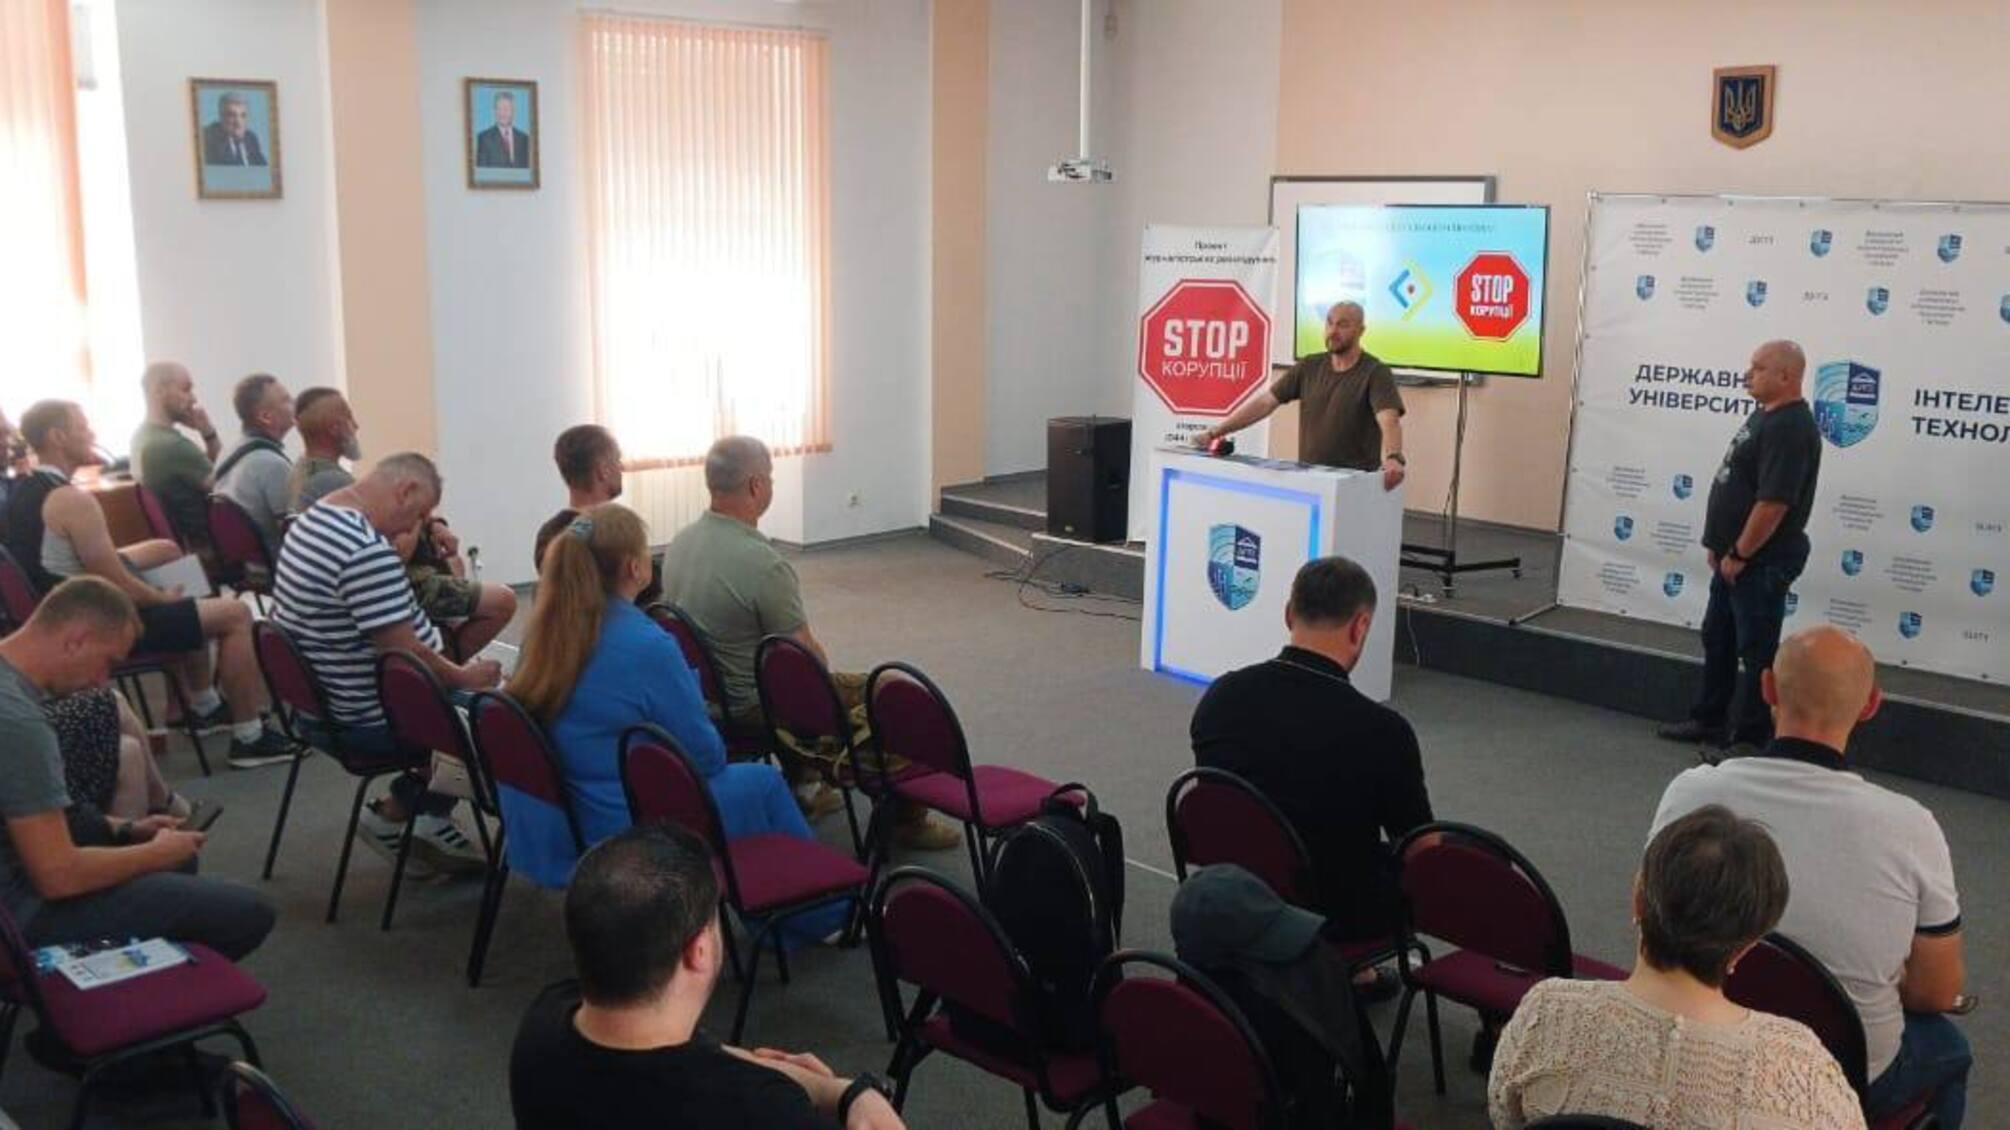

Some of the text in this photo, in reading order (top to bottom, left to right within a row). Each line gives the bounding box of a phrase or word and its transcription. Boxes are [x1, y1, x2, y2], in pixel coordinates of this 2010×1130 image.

[1471, 274, 1514, 304] STOP
[1163, 318, 1249, 358] STOP
[1162, 360, 1248, 381] КОРУПЦІЇ
[1635, 364, 1750, 389] ДЕРЖАВН
